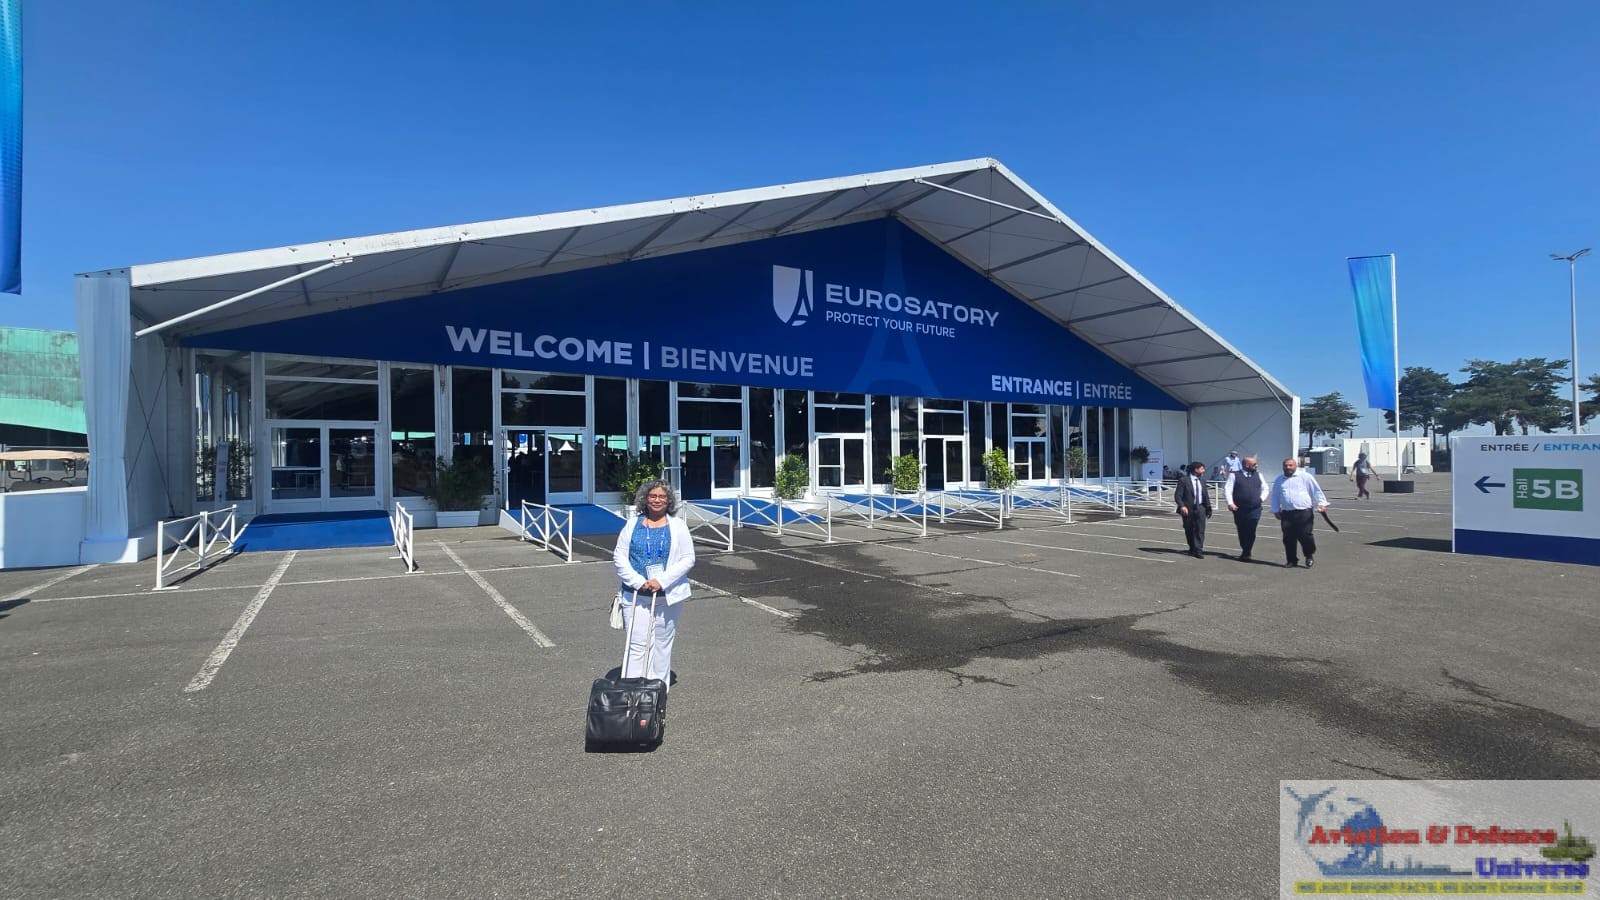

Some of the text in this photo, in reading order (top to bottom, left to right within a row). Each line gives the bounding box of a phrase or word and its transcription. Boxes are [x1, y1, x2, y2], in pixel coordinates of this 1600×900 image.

[826, 283, 999, 327] EUROSATORY
[826, 311, 956, 338] PROTECT YOUR FUTURE
[446, 326, 633, 365] WELCOME
[661, 346, 814, 377] BIENVENUE
[991, 375, 1073, 398] ENTRANCE
[1083, 383, 1132, 400] ENTRÉE
[1480, 443, 1529, 452] ENTRÉE
[1532, 443, 1540, 452] /
[1515, 478, 1528, 499] Hall
[1532, 479, 1580, 500] 5B
